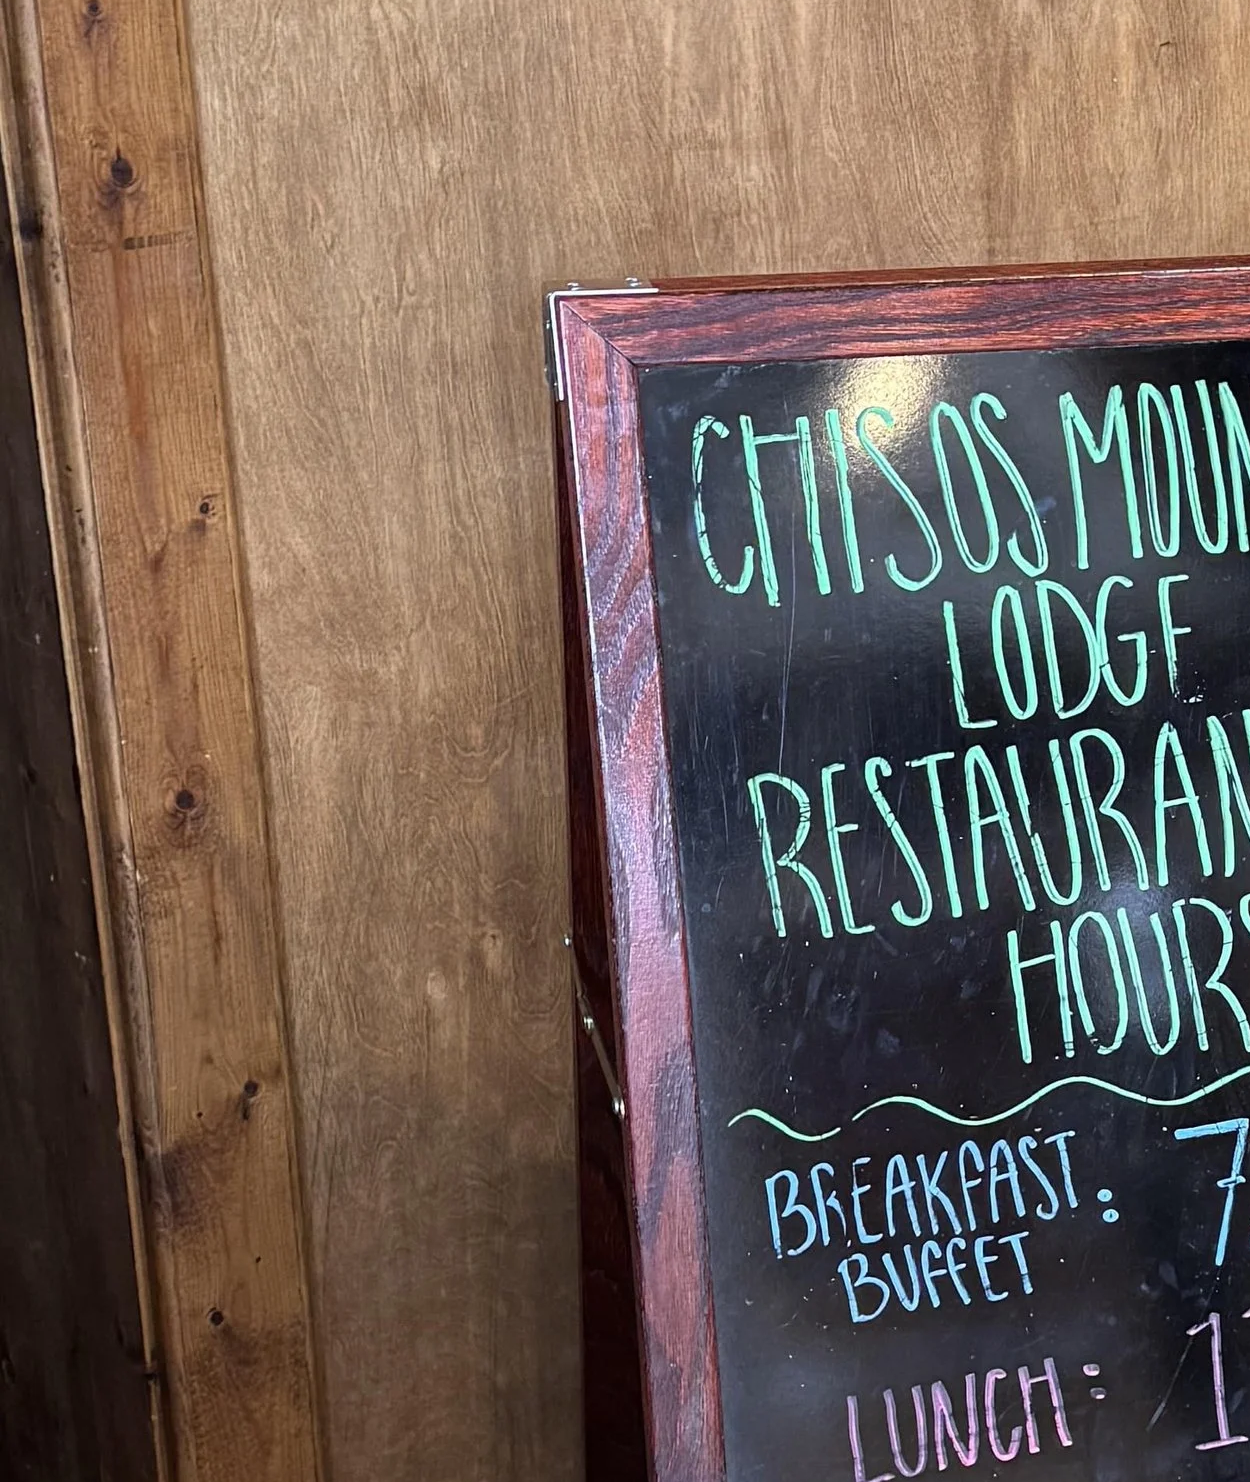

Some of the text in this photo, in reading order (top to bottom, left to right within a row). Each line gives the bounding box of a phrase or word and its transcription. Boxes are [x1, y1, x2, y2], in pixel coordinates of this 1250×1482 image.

[691, 393, 1049, 607] CHISOS
[942, 574, 1202, 729] LODGE
[836, 1231, 1035, 1323] BUFFET
